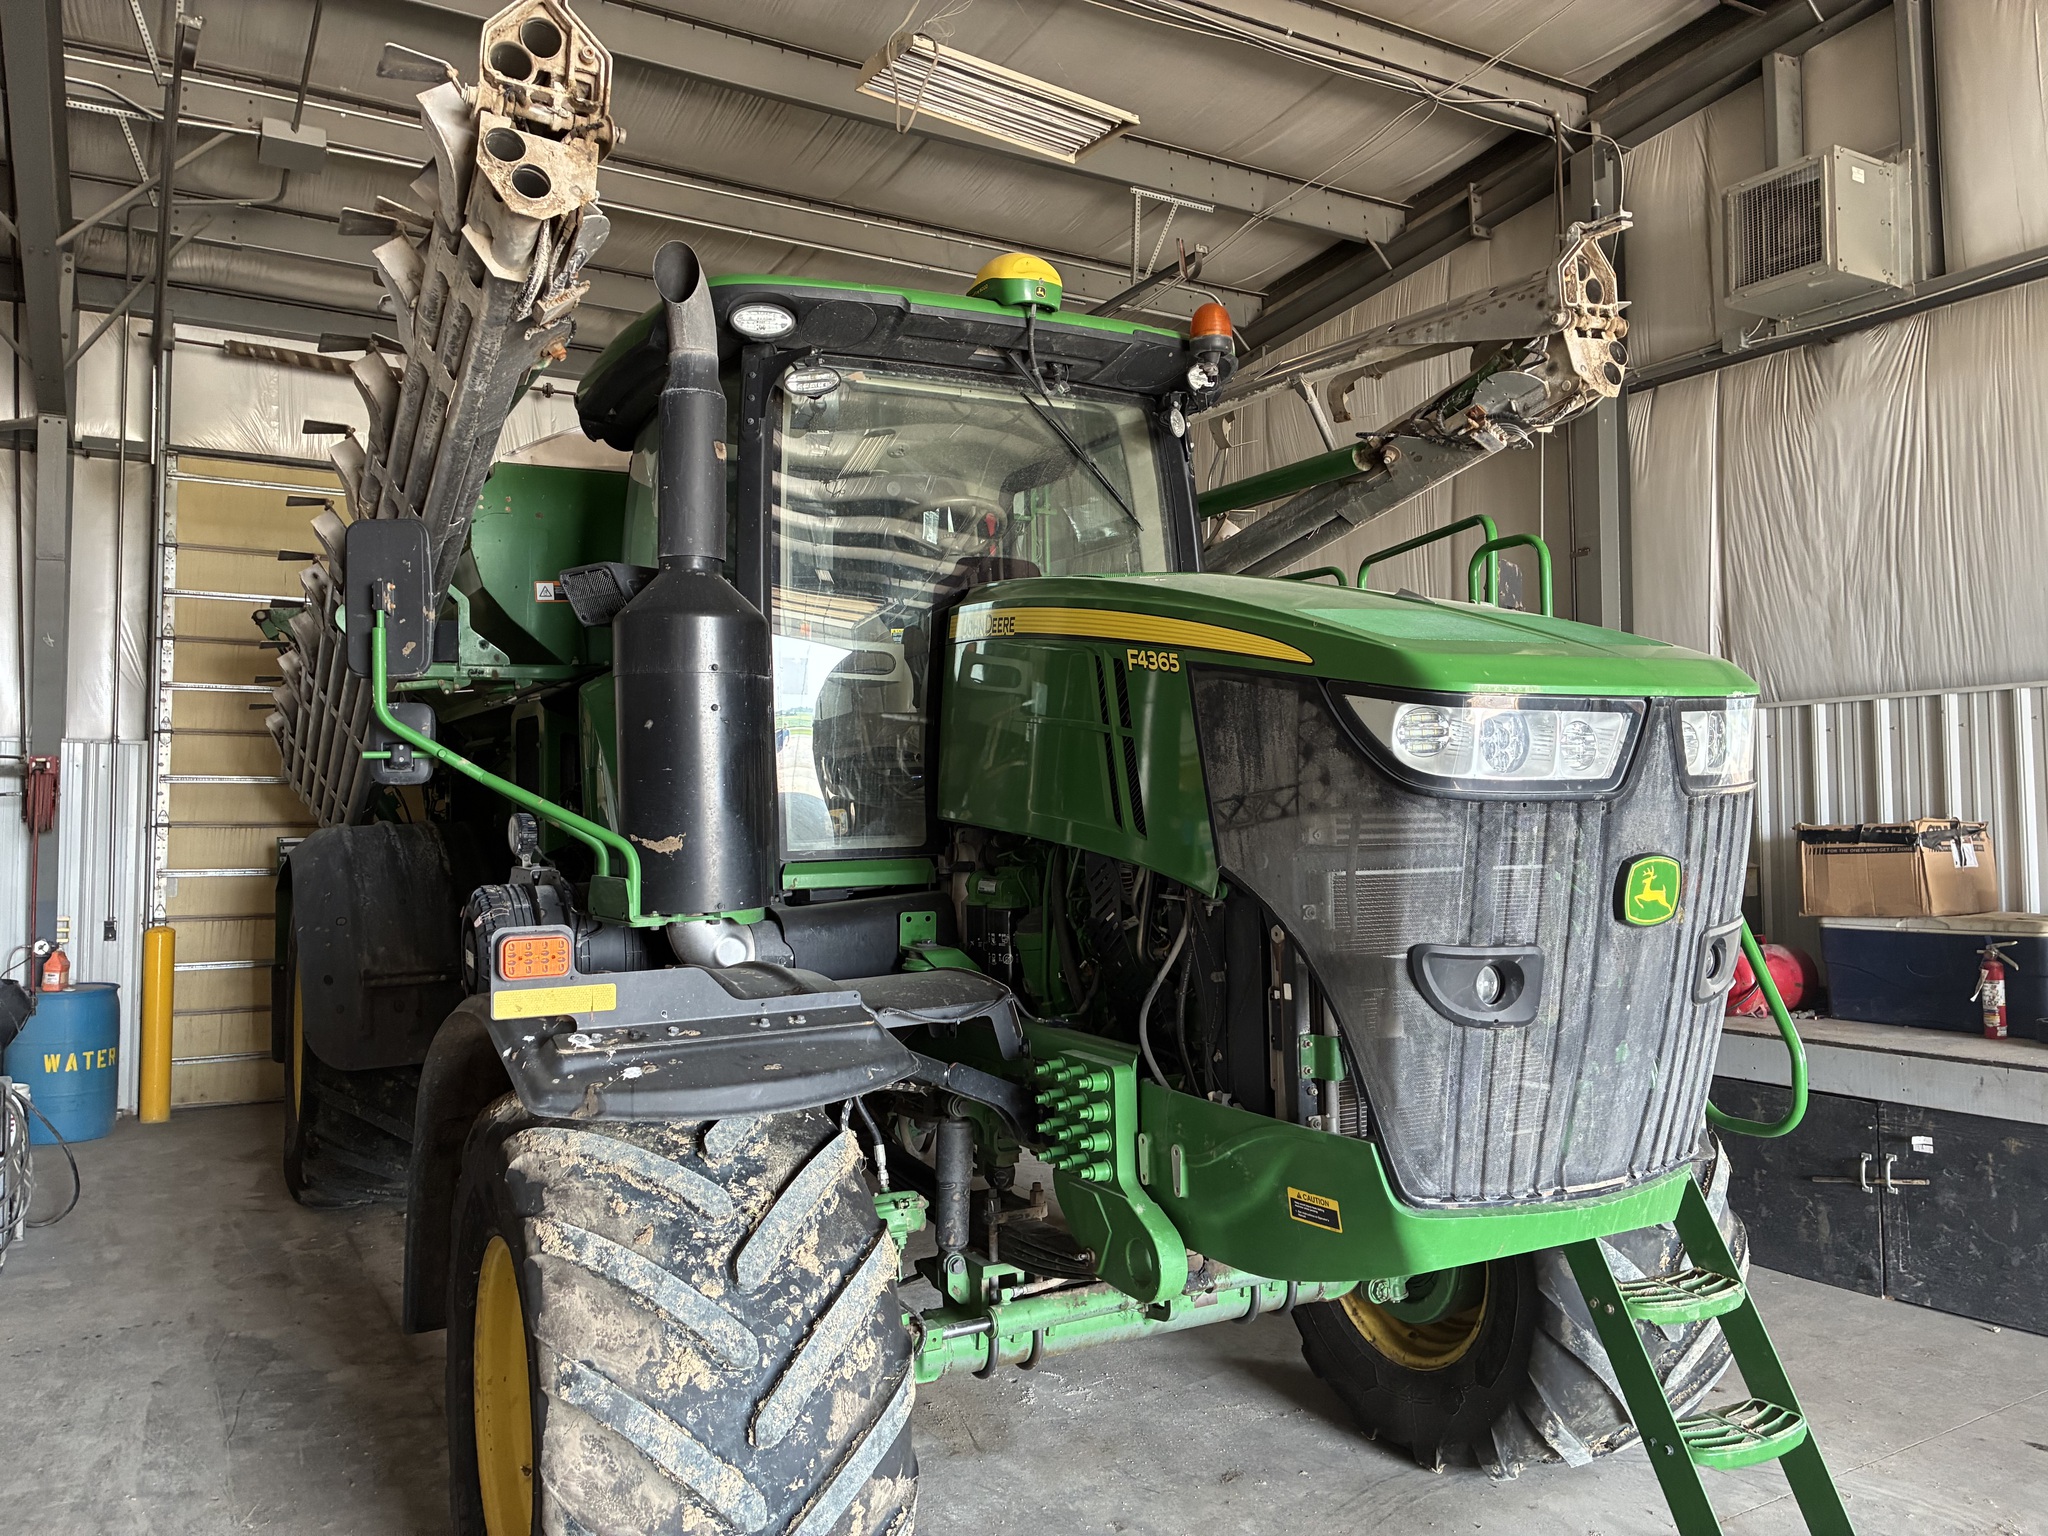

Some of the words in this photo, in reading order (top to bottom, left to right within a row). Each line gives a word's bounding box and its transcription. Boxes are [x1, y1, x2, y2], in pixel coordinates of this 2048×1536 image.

[985, 614, 1016, 635] DEERE
[1126, 648, 1180, 673] F4365
[43, 1046, 117, 1074] WATER
[1302, 1193, 1330, 1208] CAUTION
